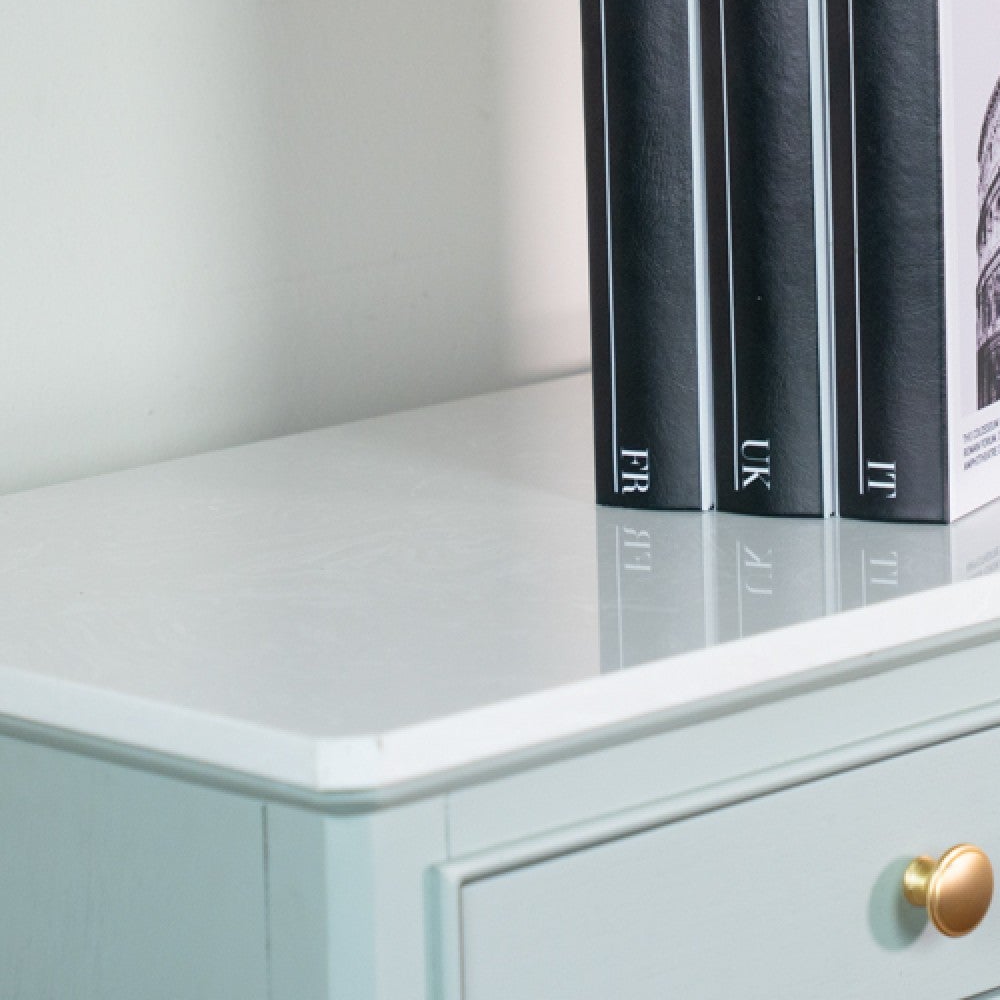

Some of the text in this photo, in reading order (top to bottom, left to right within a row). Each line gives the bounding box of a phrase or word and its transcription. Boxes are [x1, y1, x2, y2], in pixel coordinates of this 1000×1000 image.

[621, 448, 649, 495] FR
[741, 439, 771, 491] UK
[867, 461, 897, 499] IT
